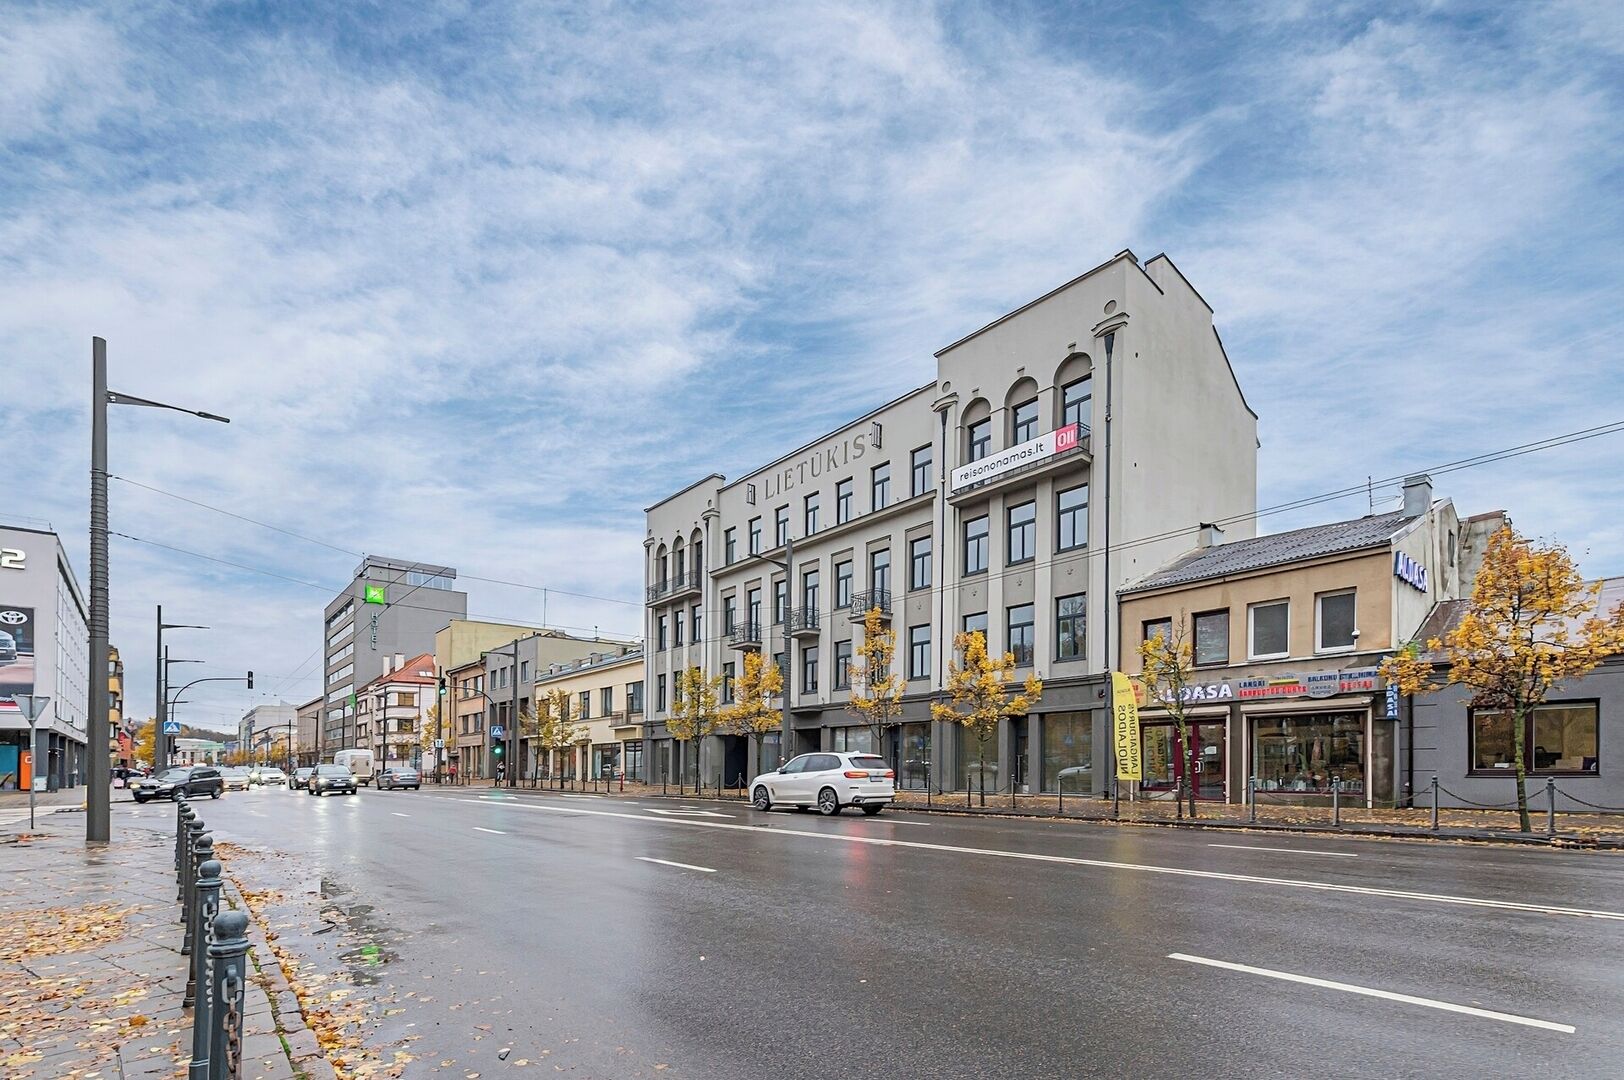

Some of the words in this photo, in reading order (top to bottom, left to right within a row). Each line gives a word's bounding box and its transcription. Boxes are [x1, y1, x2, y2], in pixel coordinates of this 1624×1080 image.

[960, 443, 1044, 482] reisononamas.lt
[0, 548, 25, 570] 2
[1239, 680, 1265, 688] LANGAI
[1386, 684, 1395, 716] LDASA
